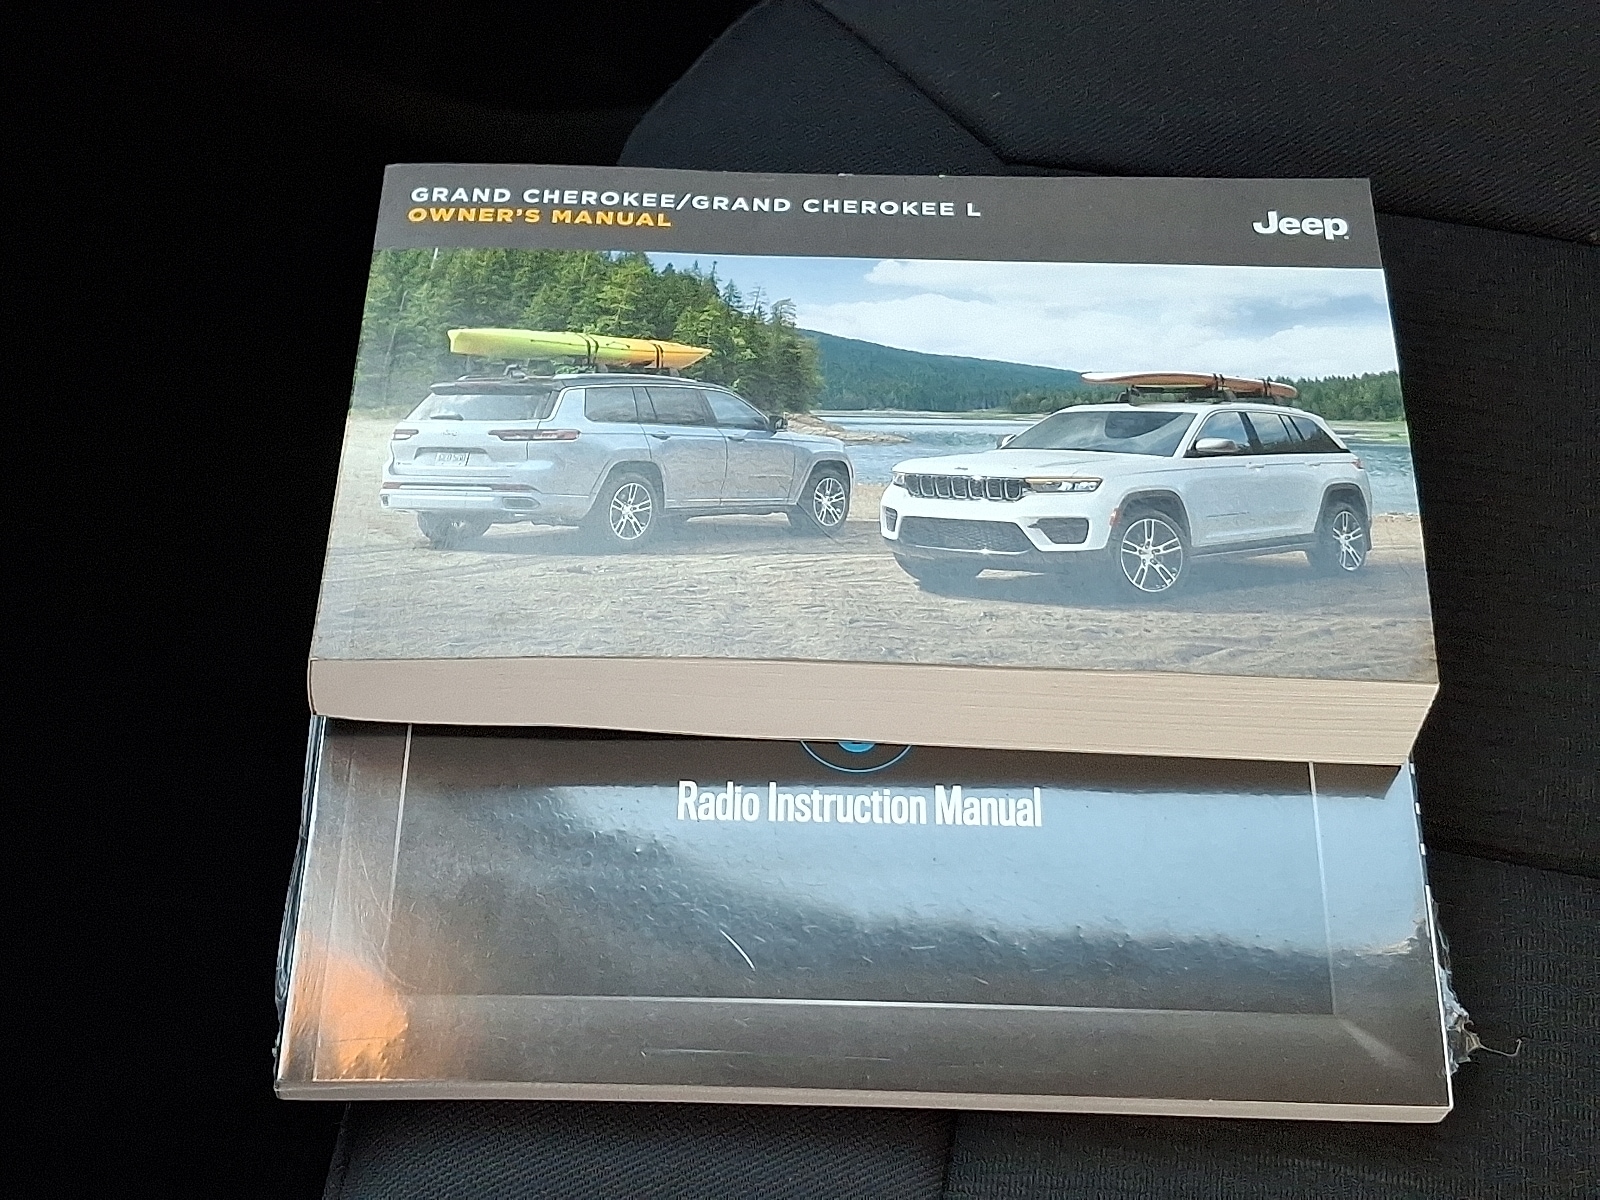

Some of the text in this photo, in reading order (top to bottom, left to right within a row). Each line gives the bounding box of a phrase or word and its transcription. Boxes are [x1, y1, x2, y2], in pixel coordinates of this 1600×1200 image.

[407, 207, 673, 227] OWNER'S MANUAL
[410, 187, 982, 218] GRAND CHEROKEE/GRAND CHEROKEE L
[1252, 210, 1349, 241] Jeep
[676, 780, 1043, 828] Radio Instruction Manual
